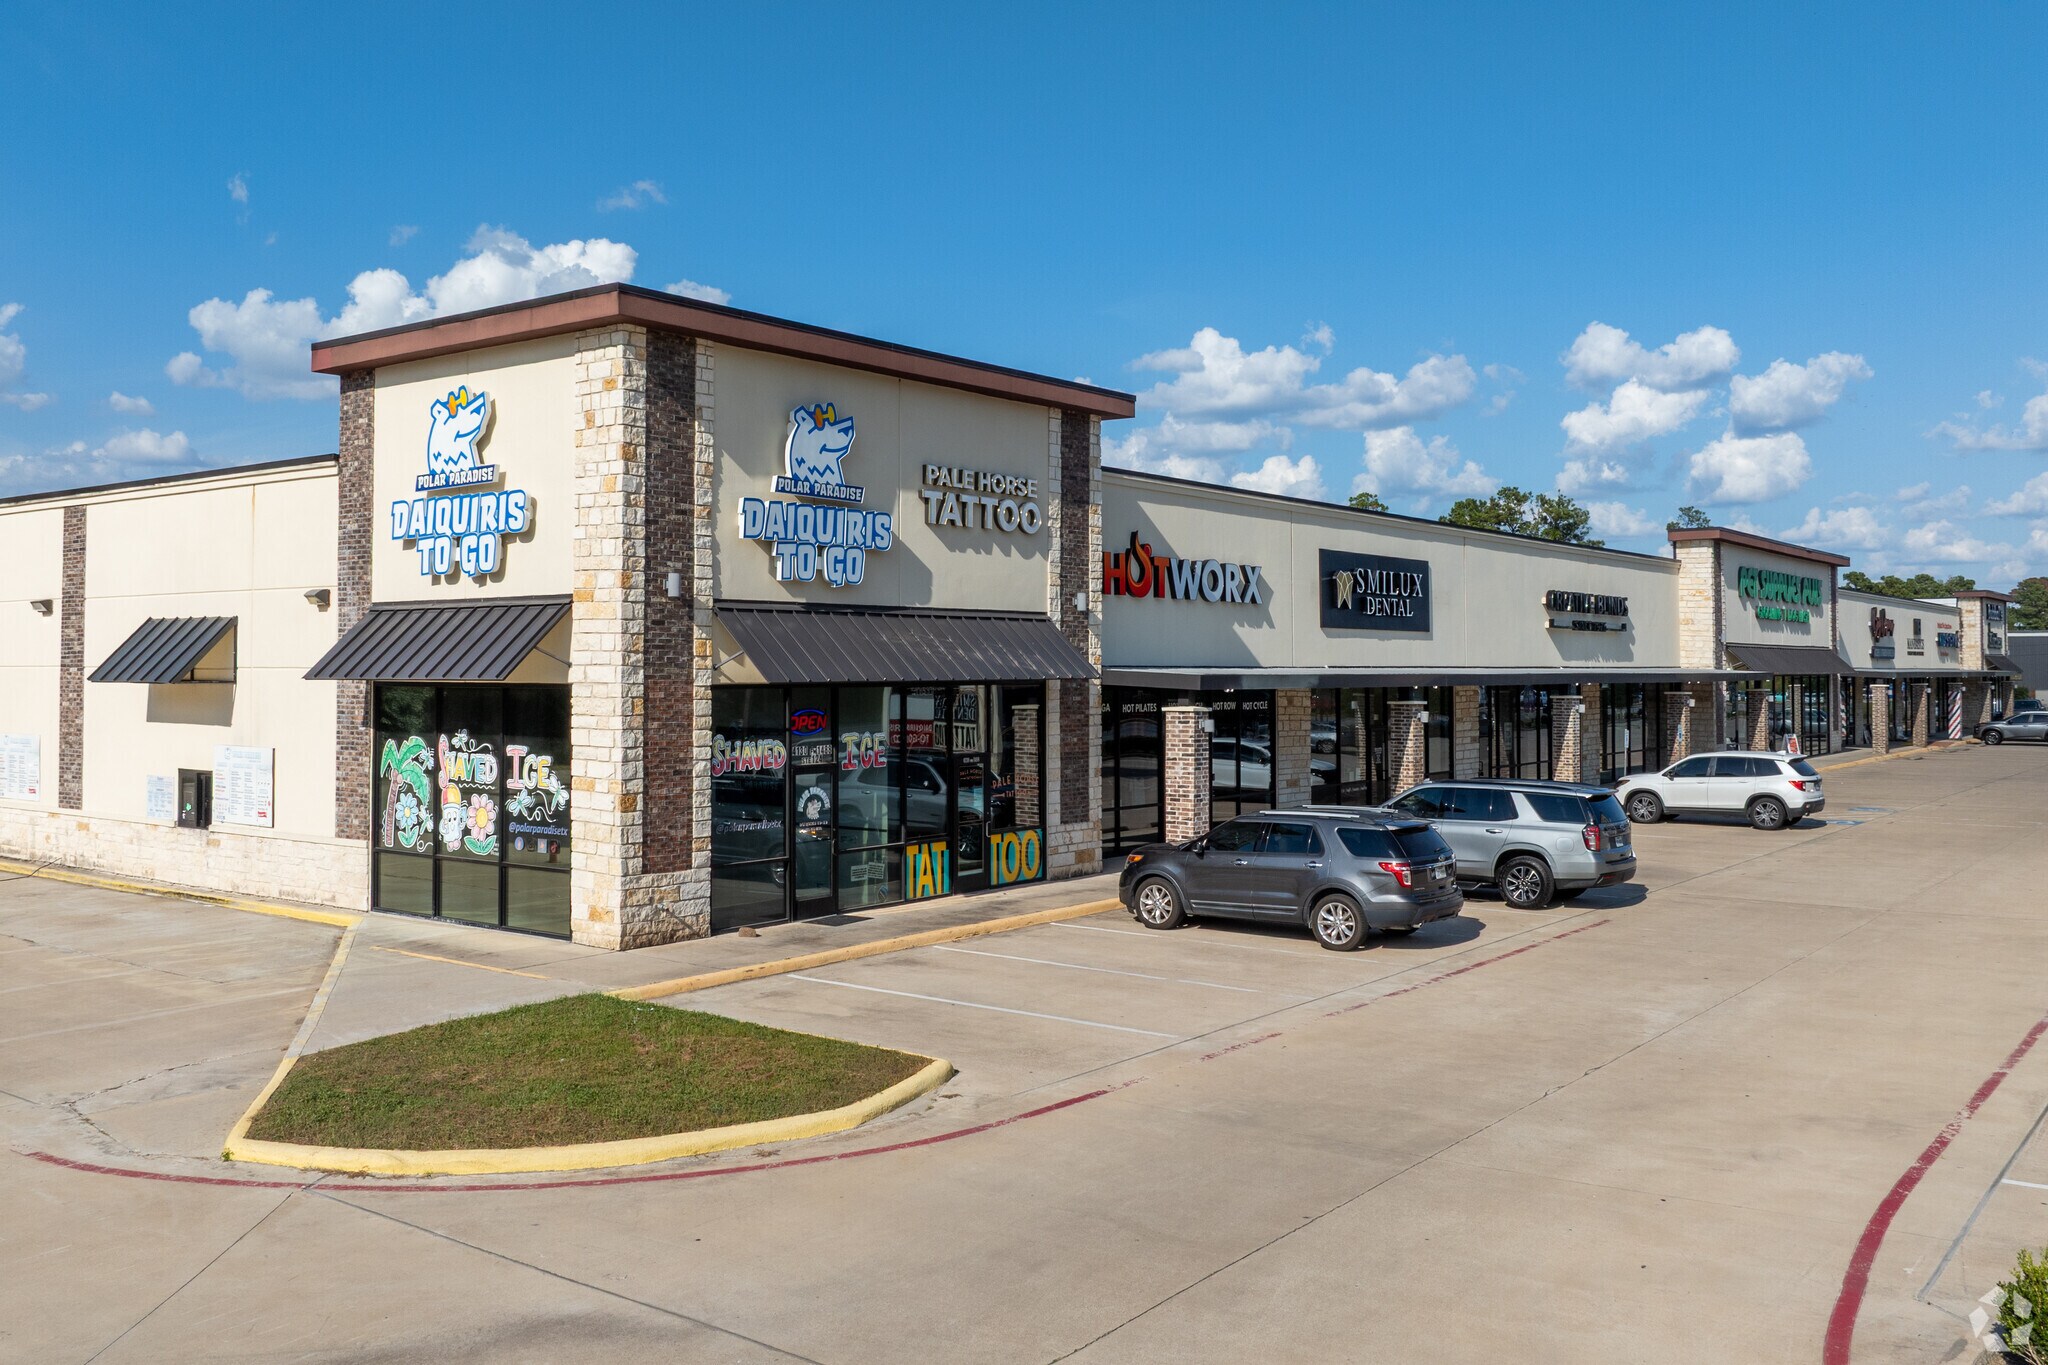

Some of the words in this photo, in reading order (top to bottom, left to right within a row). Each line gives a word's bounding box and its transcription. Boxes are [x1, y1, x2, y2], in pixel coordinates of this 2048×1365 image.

[417, 473, 446, 489] POLAR
[449, 467, 494, 485] PARADISE
[778, 478, 810, 494] POLAR
[814, 482, 863, 501] PARADISE
[924, 464, 975, 490] PALE
[979, 471, 1038, 498] HORSE
[391, 489, 528, 540] DAIQUIRIS
[742, 497, 893, 551] DAIQUIRIS
[920, 488, 1041, 534] TATTOO
[417, 534, 451, 576] TO
[460, 531, 497, 577] GO
[775, 541, 817, 581] TO
[825, 544, 865, 587] GO
[1102, 530, 1263, 605] HOTWORX
[1356, 568, 1424, 597] SMILUX
[1738, 566, 1758, 598] PET
[1758, 570, 1800, 603] SUPPLIES
[1801, 577, 1822, 607] PLUS
[1366, 596, 1414, 618] DENTAL
[791, 714, 828, 731] OPEN
[1101, 703, 1111, 712] GA
[1122, 703, 1135, 713] HOT
[1135, 703, 1157, 713] PILATES
[1212, 702, 1223, 710] HOT
[1223, 701, 1236, 710] ROW
[1242, 702, 1252, 710] HOT
[1252, 701, 1268, 710] CYCLE
[438, 734, 498, 789] SHAVED
[506, 745, 553, 789] ICE
[711, 733, 787, 777] SHAVED
[841, 731, 888, 771] ICE
[906, 841, 947, 899] TAT
[991, 829, 1041, 886] TOO
